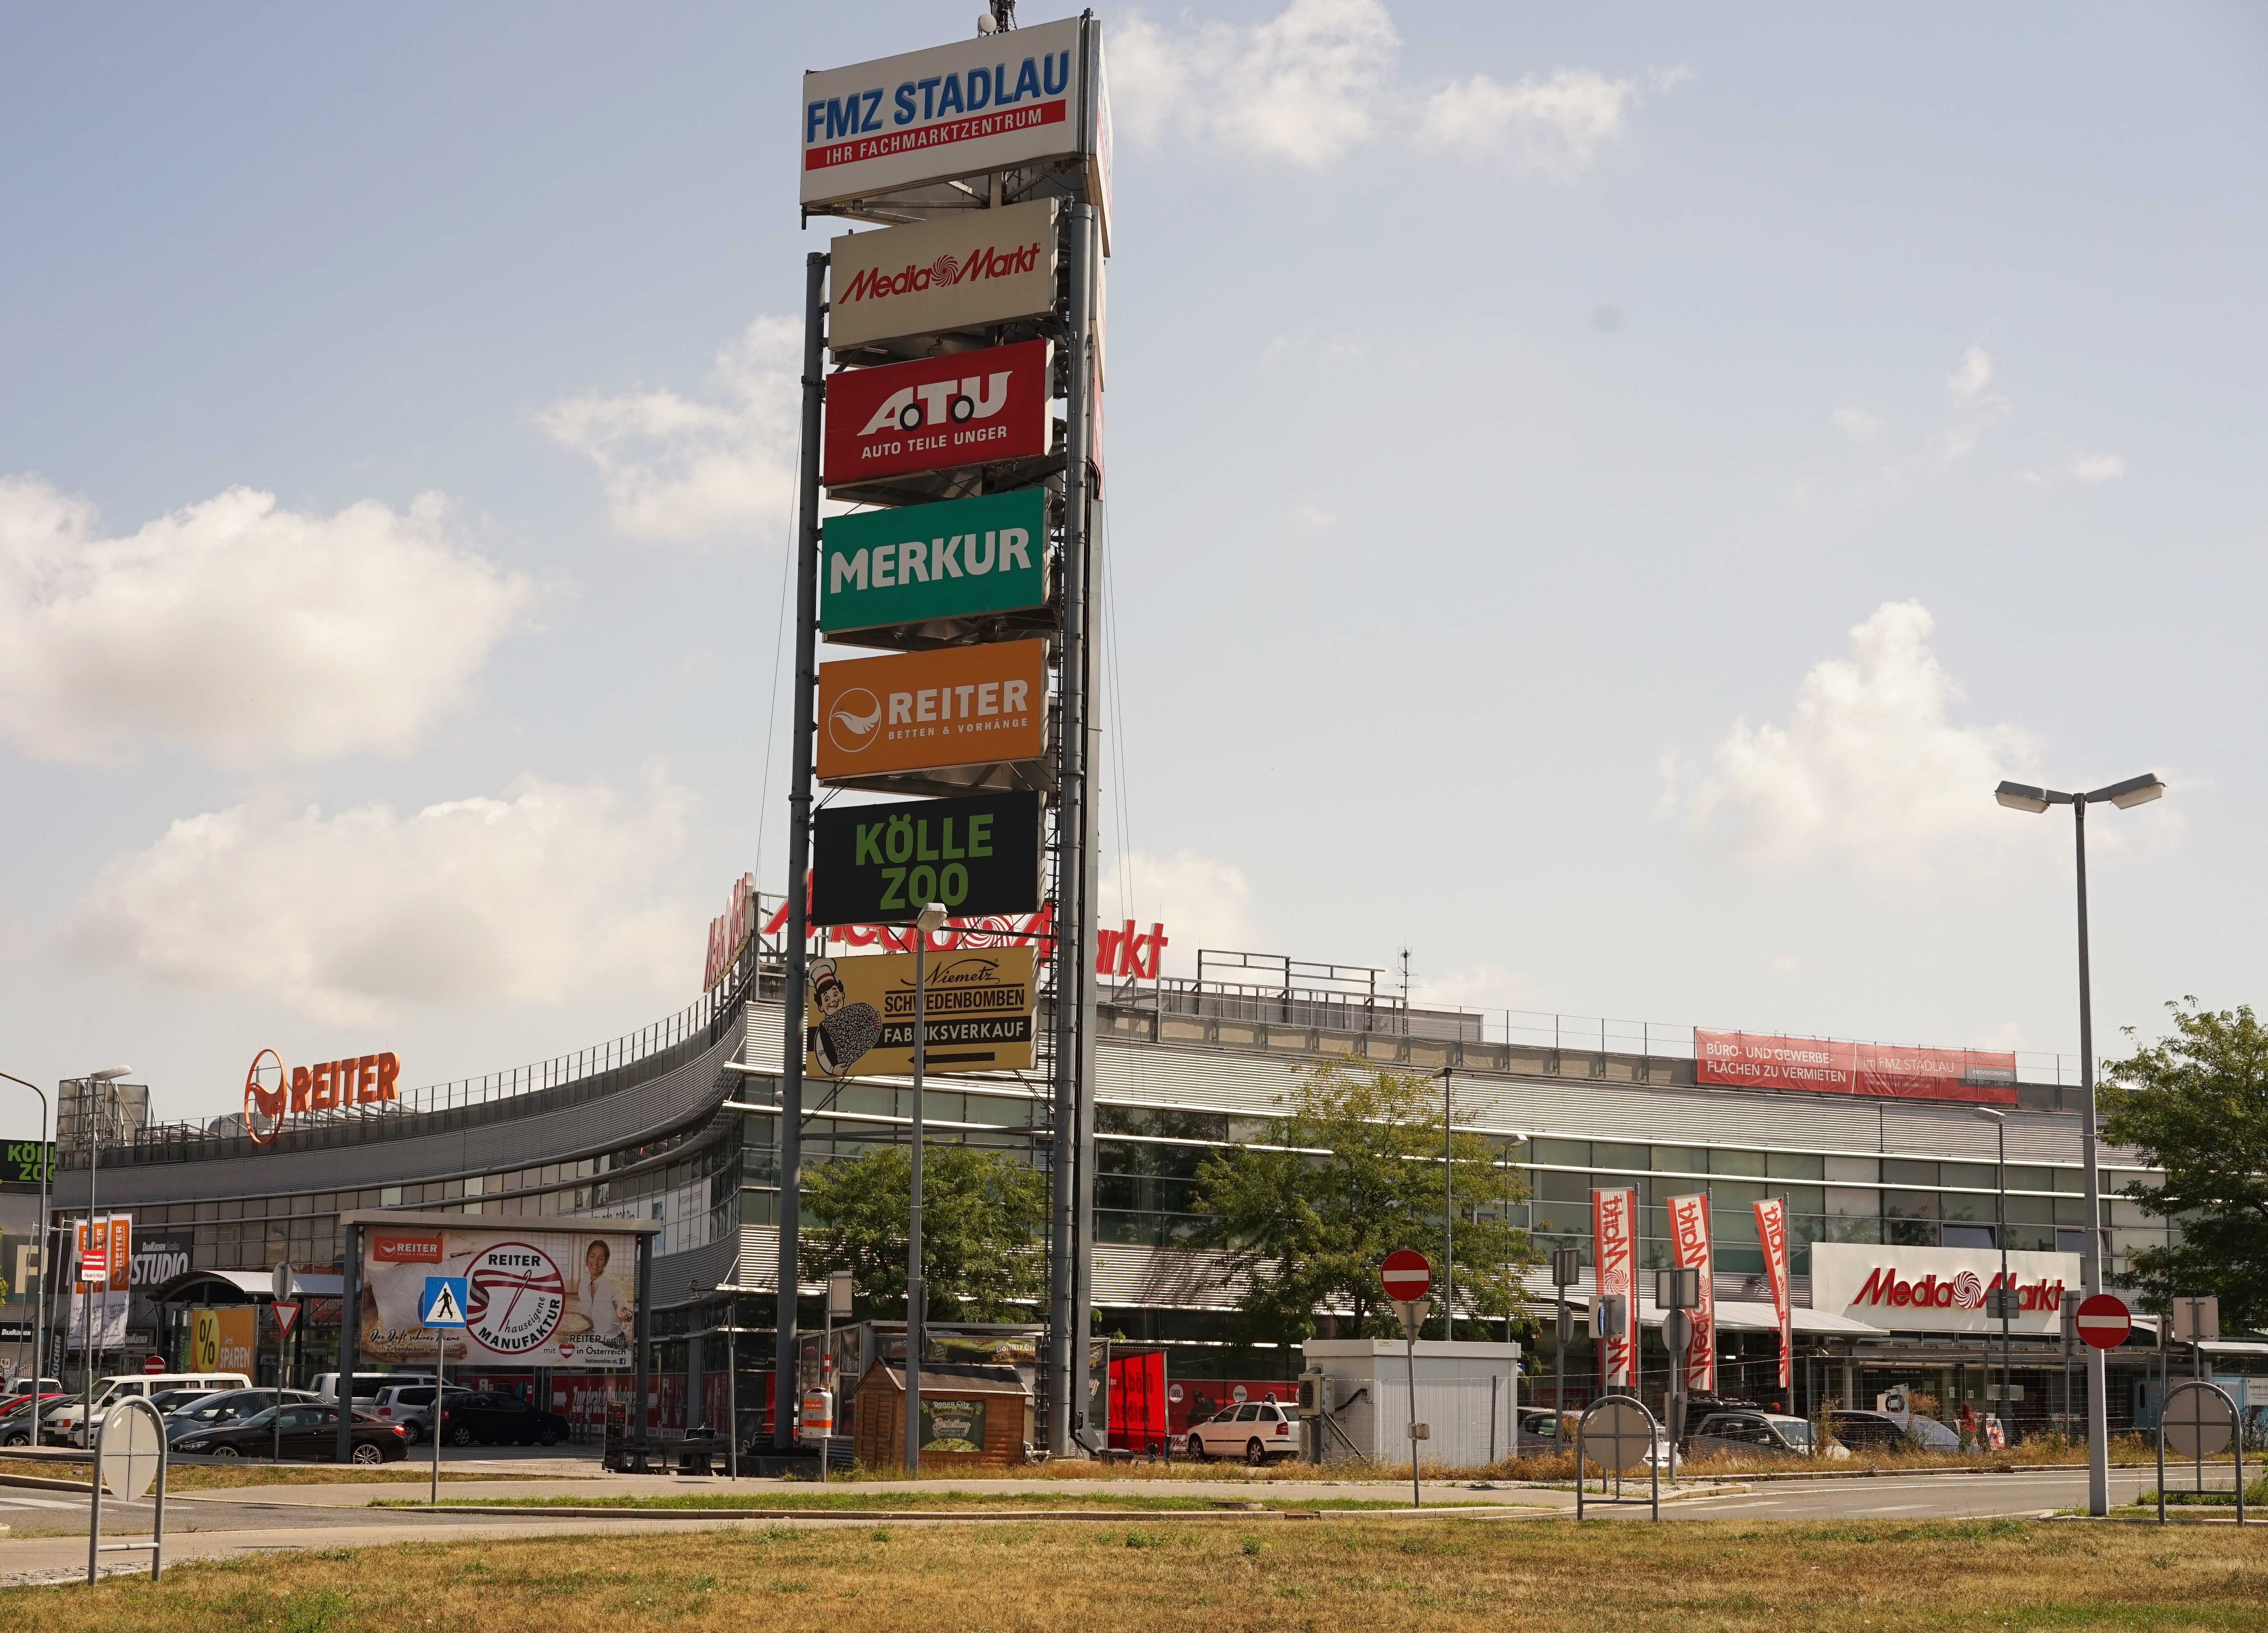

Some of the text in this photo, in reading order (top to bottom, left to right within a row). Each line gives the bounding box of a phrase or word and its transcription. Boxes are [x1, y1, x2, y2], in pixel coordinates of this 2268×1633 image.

[807, 87, 883, 143] FMZ
[894, 50, 1069, 125] STADLAU
[826, 108, 1042, 164] IHR FACHMARKTZENTRUM
[838, 242, 1040, 305] Media Markt
[862, 426, 1007, 459] AUTO TEILE UNGER
[830, 528, 1031, 594] MERKUR
[889, 679, 1028, 725] REITER
[889, 718, 1027, 740] BETTEN & VORHÄNGE
[856, 813, 994, 866] KÖLLE
[880, 863, 968, 910] ZOO
[901, 958, 1000, 986] Niemetz
[884, 1021, 1024, 1043] FABIKSVERKAUF
[1706, 1041, 1834, 1064] BÜRO- UND GEWERBE-
[1864, 1057, 1954, 1072] im FMZ STADLAU
[290, 1052, 400, 1113] REITER
[1707, 1060, 1846, 1082] FLÄCHEN ZU VERMIETEN
[8, 1142, 55, 1163] KÖLL
[397, 1243, 437, 1253] REITER
[488, 1254, 541, 1267] REITER
[1853, 1268, 1954, 1308] Media
[478, 1299, 560, 1349] MANUFAKTUR
[505, 1296, 545, 1333] hauseigene
[225, 1335, 233, 1344] Jetzt
[369, 1329, 385, 1343] Der
[387, 1329, 407, 1344] Duft
[436, 1330, 461, 1343] Täume
[586, 1345, 626, 1355] Österreich
[220, 1347, 250, 1368] SPAREN
